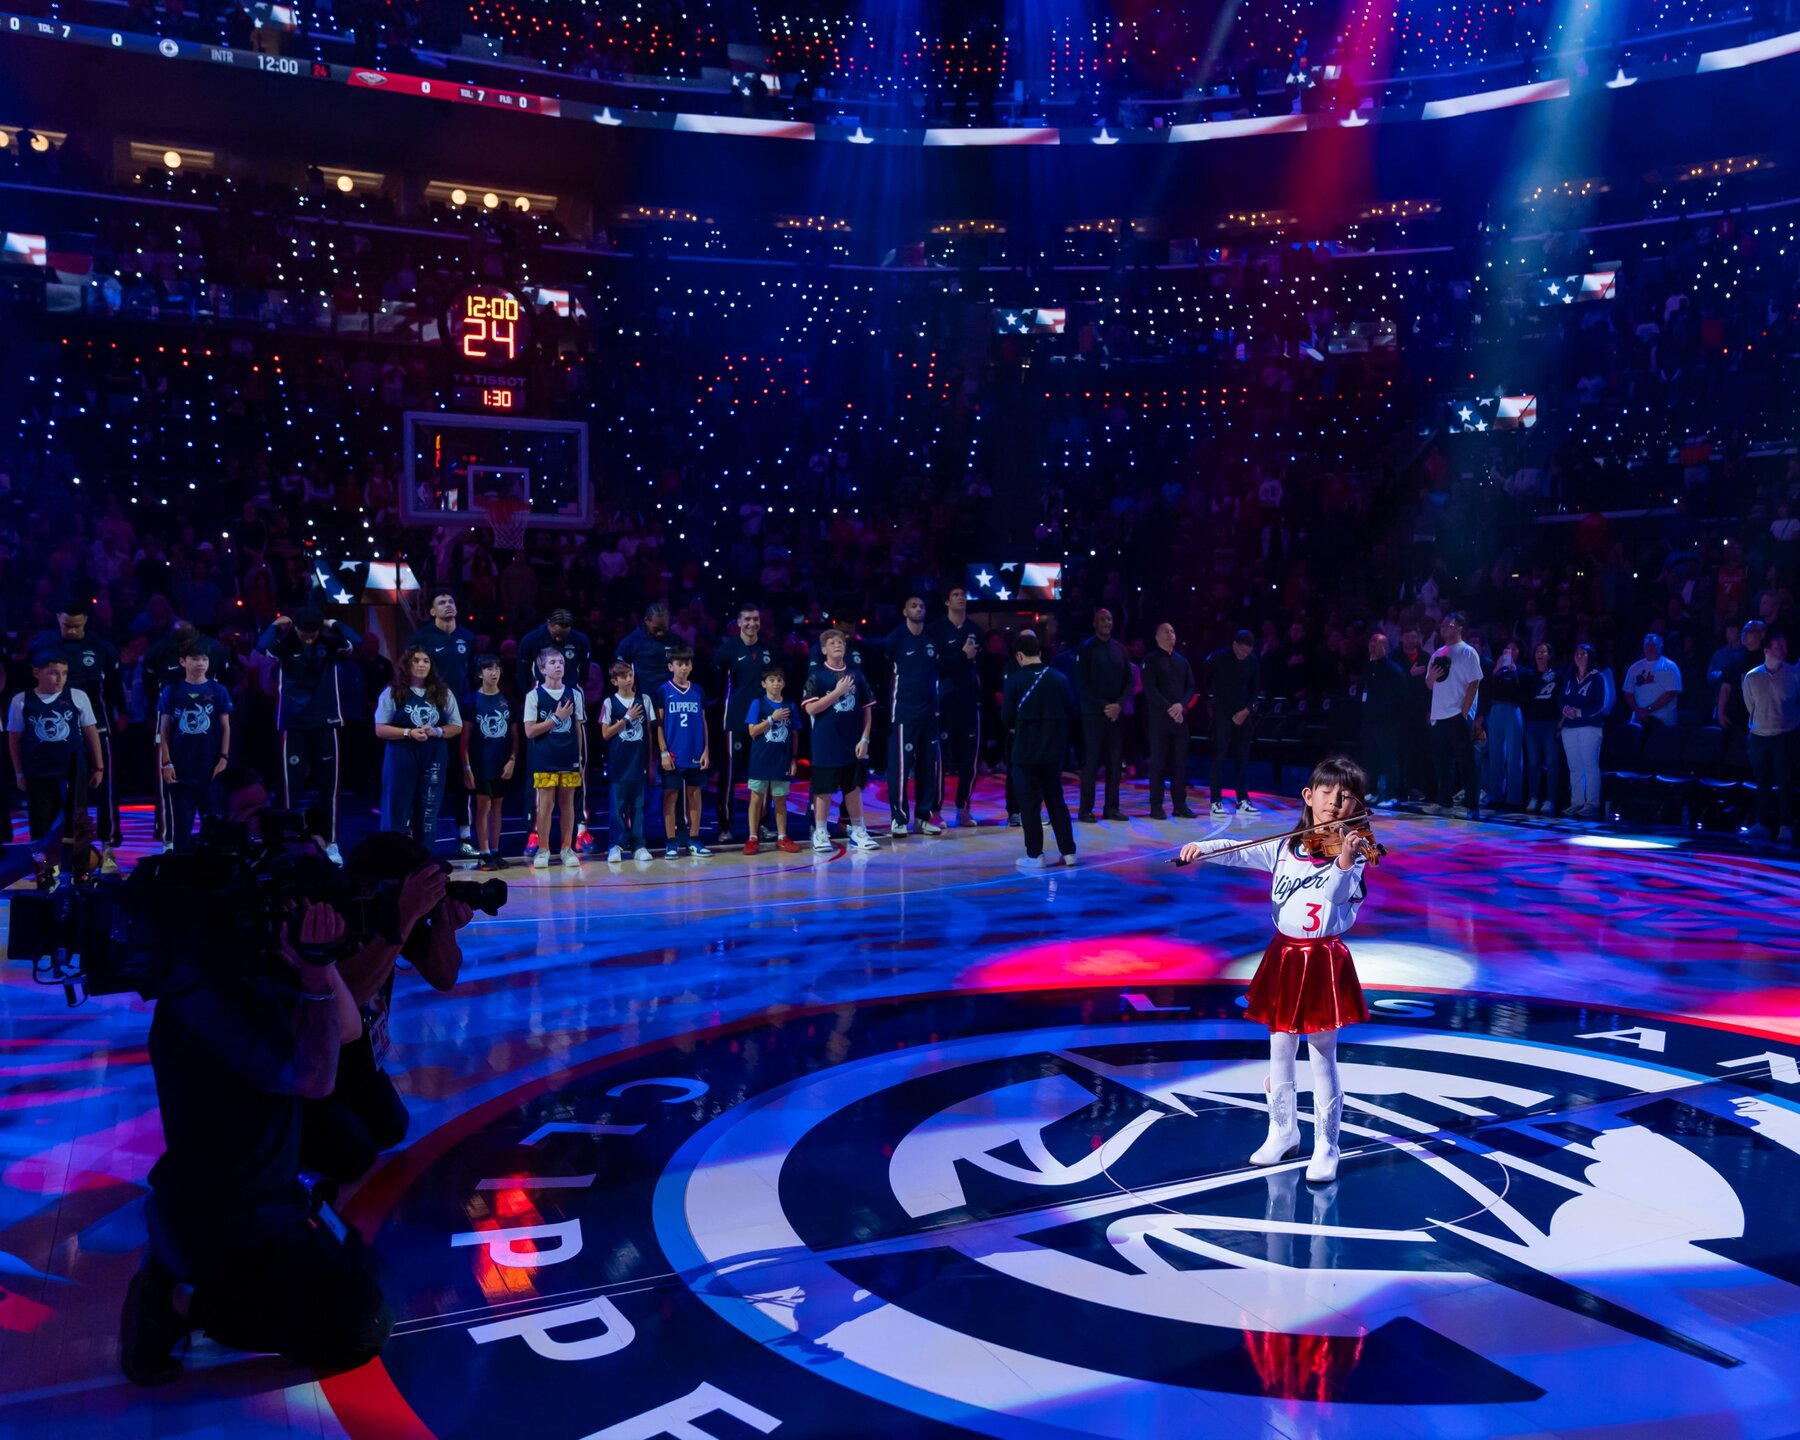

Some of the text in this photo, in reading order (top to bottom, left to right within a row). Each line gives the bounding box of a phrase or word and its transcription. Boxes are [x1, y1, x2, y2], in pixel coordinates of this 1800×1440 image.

[10, 17, 20, 31] 0
[62, 25, 71, 38] 7
[111, 33, 122, 46] 0
[211, 48, 234, 64] INTR
[257, 55, 299, 75] 12:00
[314, 65, 327, 77] 24
[421, 81, 430, 94] 0
[477, 90, 485, 102] 7
[518, 96, 527, 109] 0
[467, 295, 519, 321] 12:00
[463, 317, 515, 359] 24
[473, 373, 527, 388] TISSOT
[483, 390, 512, 407] 1:30
[669, 702, 698, 714] CLIPPERS
[680, 713, 688, 727] 2
[1274, 875, 1330, 900] lipper
[1302, 902, 1323, 932] 3
[1119, 993, 1436, 1018] LS
